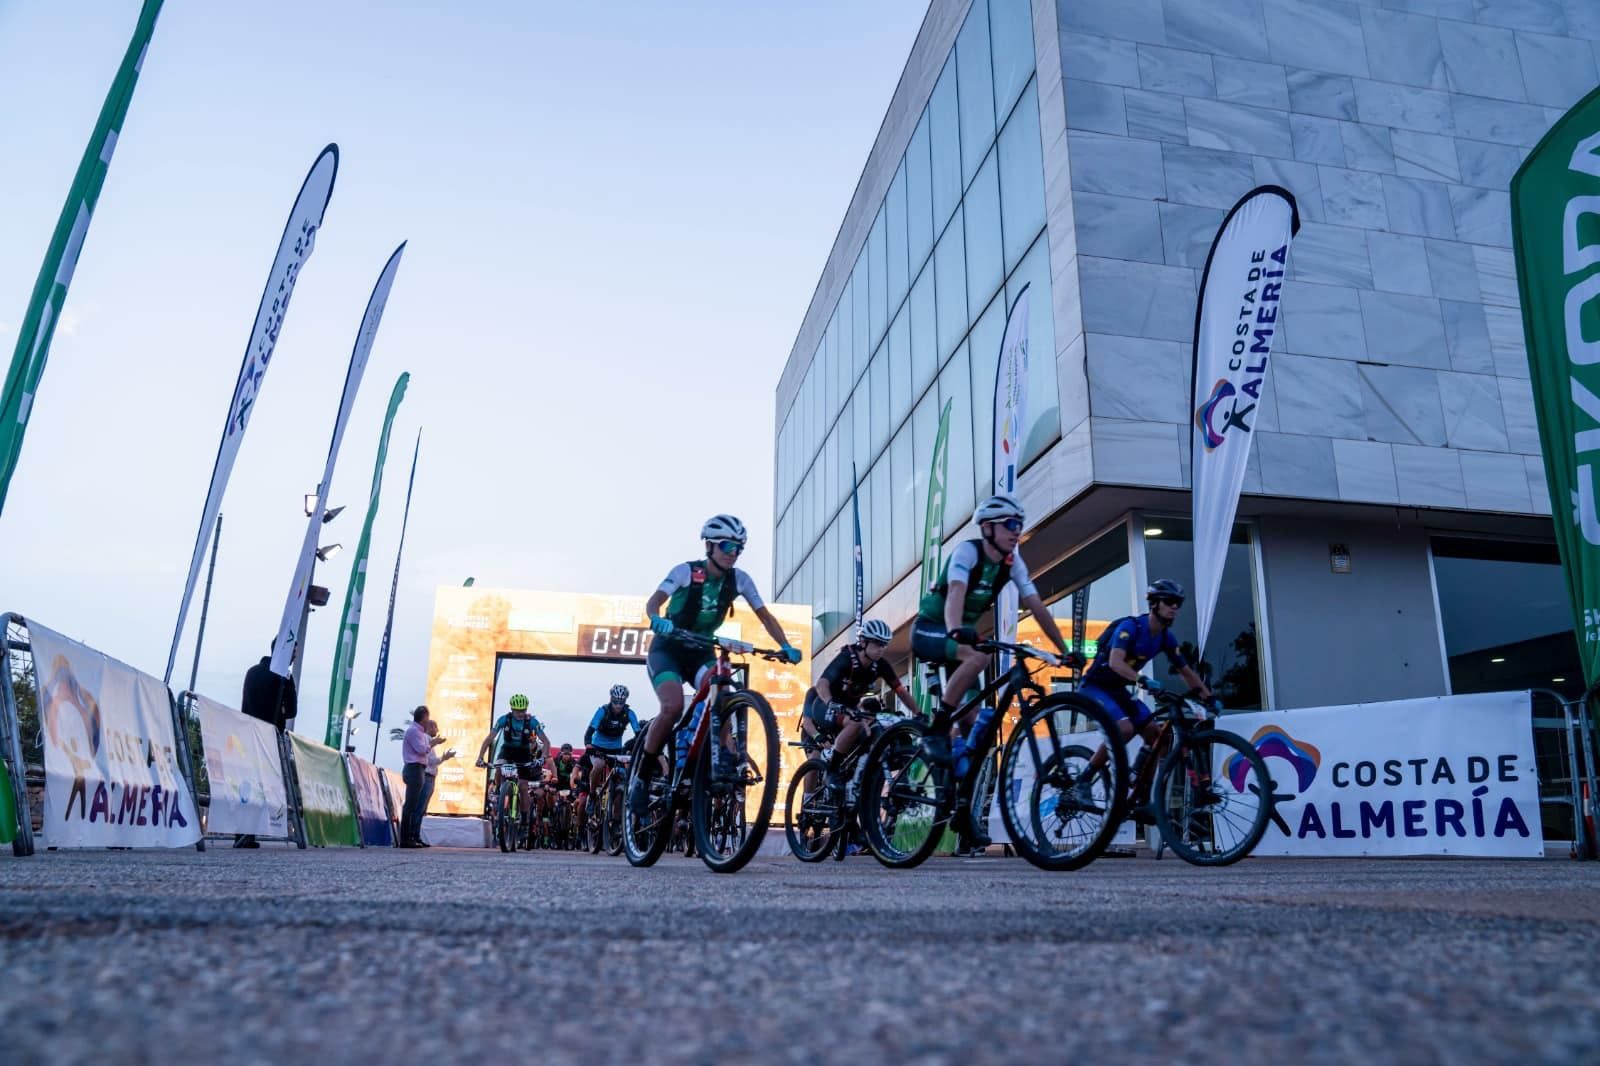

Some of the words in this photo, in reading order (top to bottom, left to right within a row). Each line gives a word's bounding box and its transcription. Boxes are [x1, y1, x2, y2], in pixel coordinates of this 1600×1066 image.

[1229, 289, 1258, 371] COSTA
[1247, 249, 1265, 281] DE
[1241, 244, 1288, 399] ALMERÍA
[1298, 785, 1530, 838] ALMERÍA
[1332, 757, 1455, 787] COSTA
[1467, 754, 1519, 783] DE
